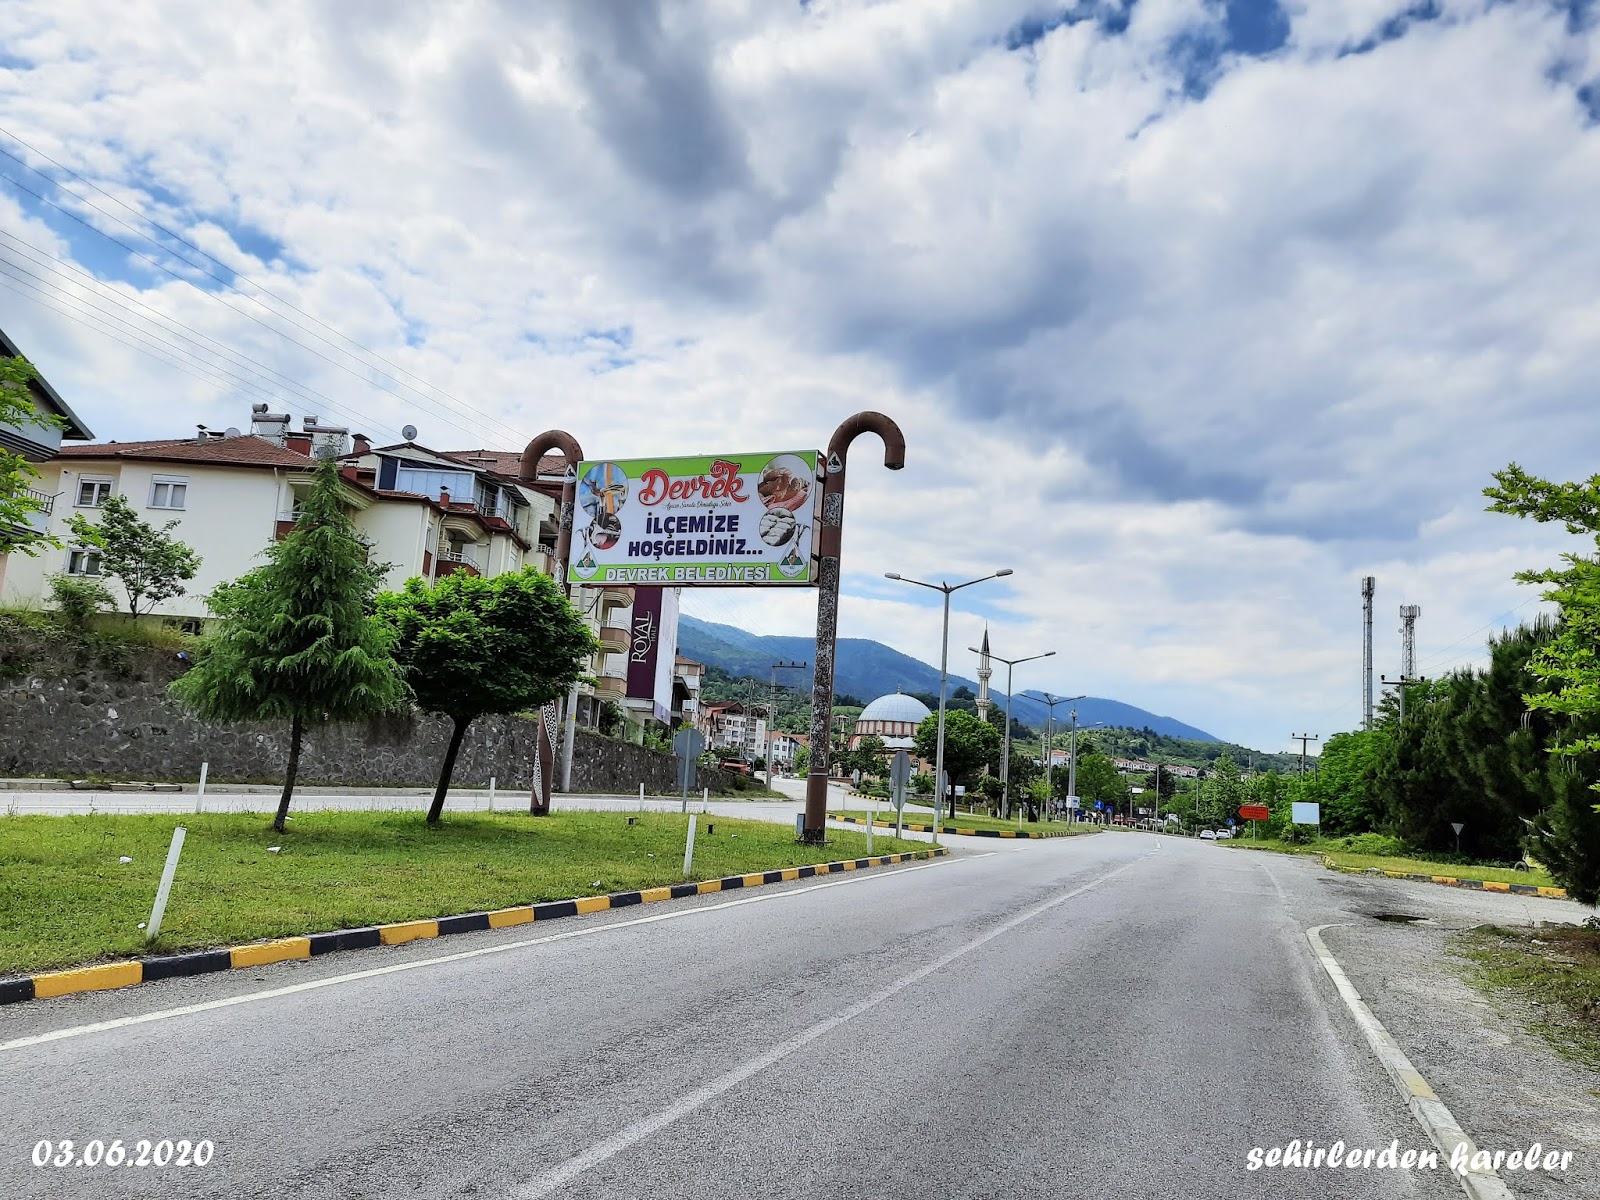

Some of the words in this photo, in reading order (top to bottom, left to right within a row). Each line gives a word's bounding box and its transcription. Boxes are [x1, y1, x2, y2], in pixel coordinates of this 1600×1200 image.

[638, 459, 750, 506] Devrek
[645, 511, 740, 539] İLÇEMİZE
[628, 535, 763, 561] HOŞGELDİNİZ...
[605, 565, 669, 581] DEVREK
[674, 563, 771, 581] BELEDİYESİ
[631, 611, 653, 664] ROYAL
